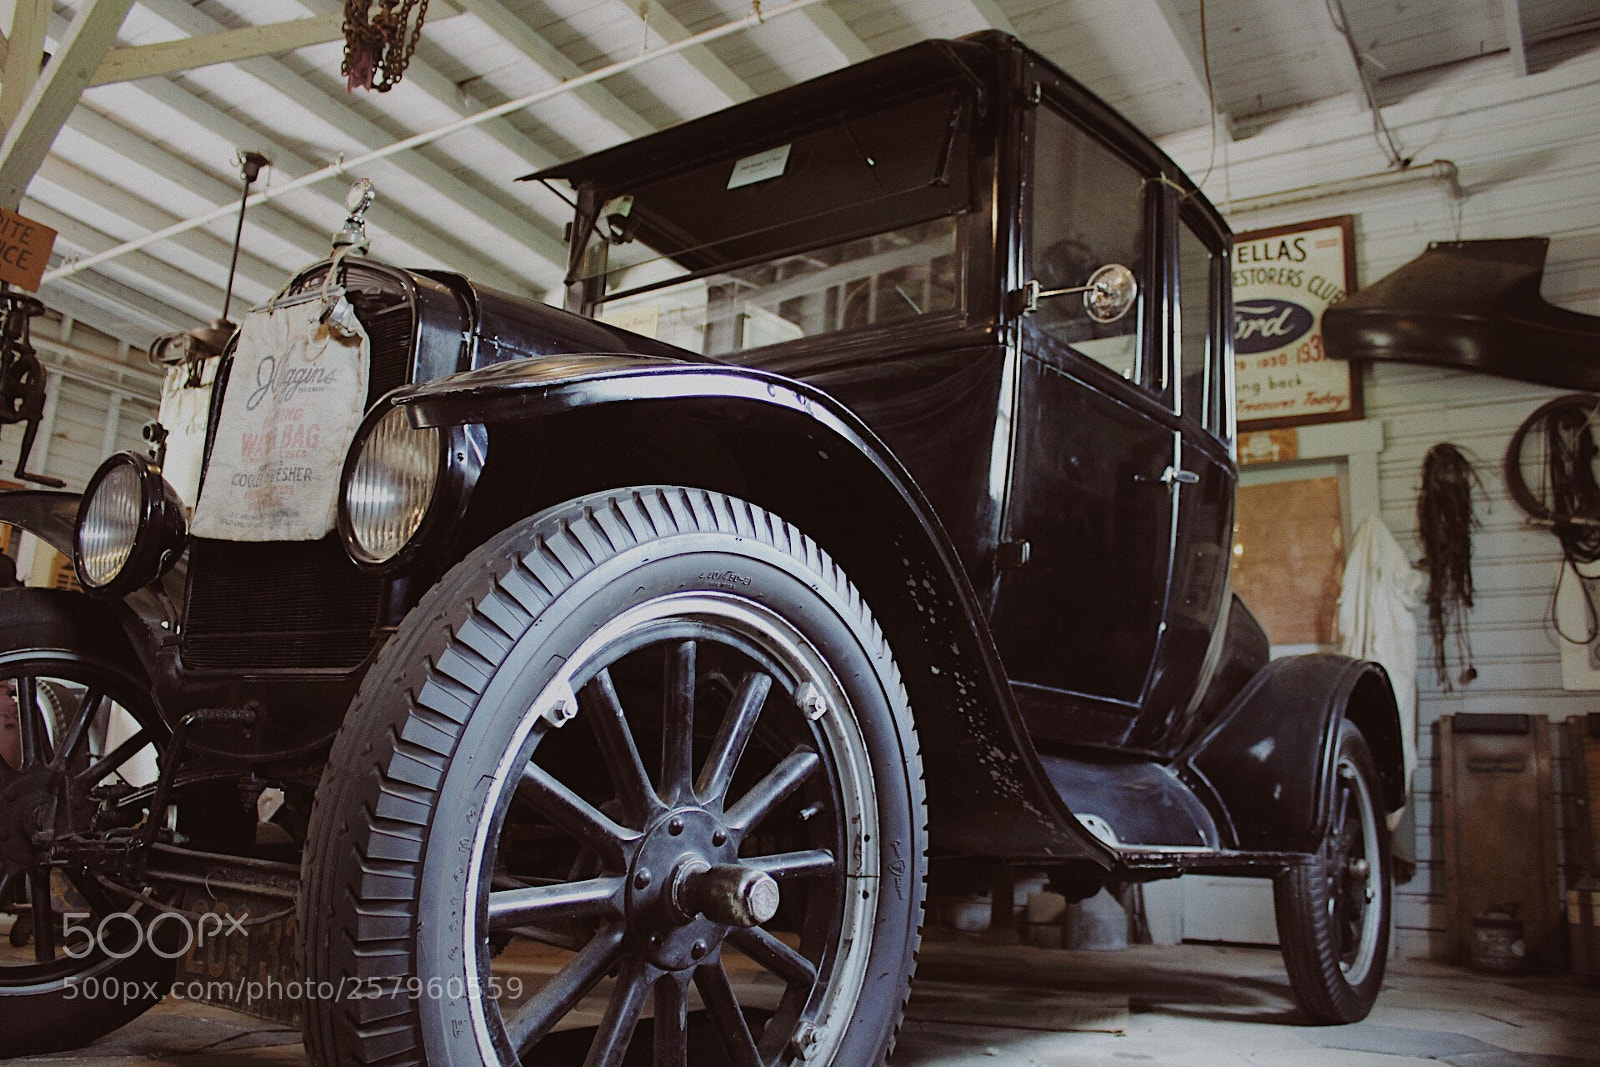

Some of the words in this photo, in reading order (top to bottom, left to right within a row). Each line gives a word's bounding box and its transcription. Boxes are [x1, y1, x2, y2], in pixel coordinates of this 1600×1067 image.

[1236, 237, 1306, 263] ELLAS
[1232, 267, 1304, 287] ESTORERS
[1234, 305, 1295, 340] ord
[1296, 334, 1325, 364] 193
